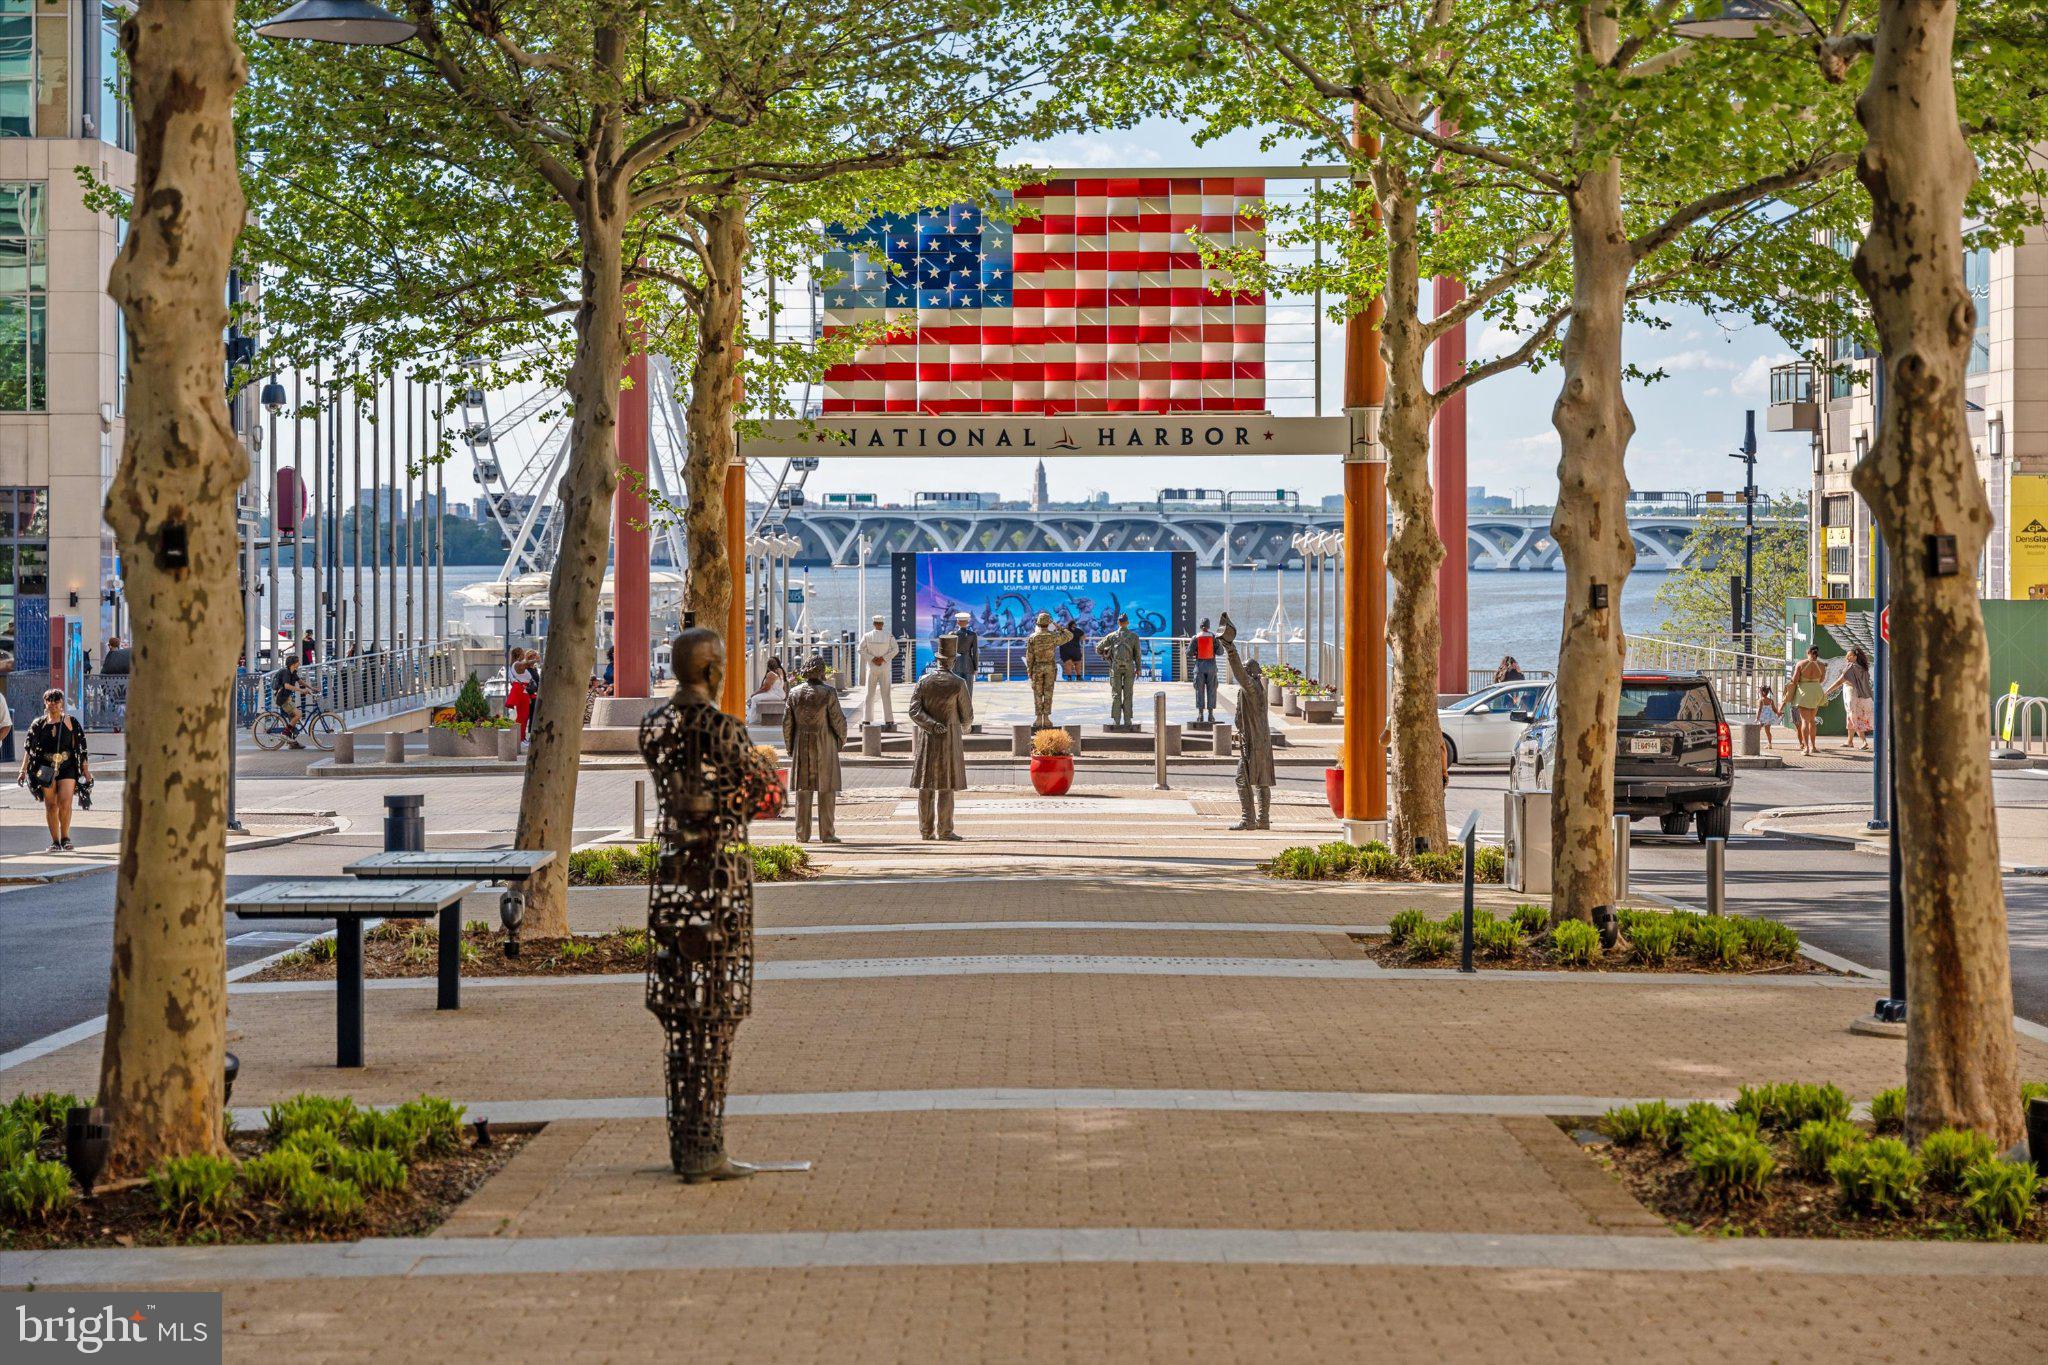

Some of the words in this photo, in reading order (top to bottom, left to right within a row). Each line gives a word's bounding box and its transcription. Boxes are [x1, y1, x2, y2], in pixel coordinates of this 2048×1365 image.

[839, 427, 1036, 448] NATIONAL
[1097, 426, 1252, 447] HARBOR
[2027, 524, 2042, 532] GP
[960, 569, 1024, 584] WILDLIFE
[1028, 569, 1088, 584] WONDER
[1092, 568, 1127, 583] BOAT
